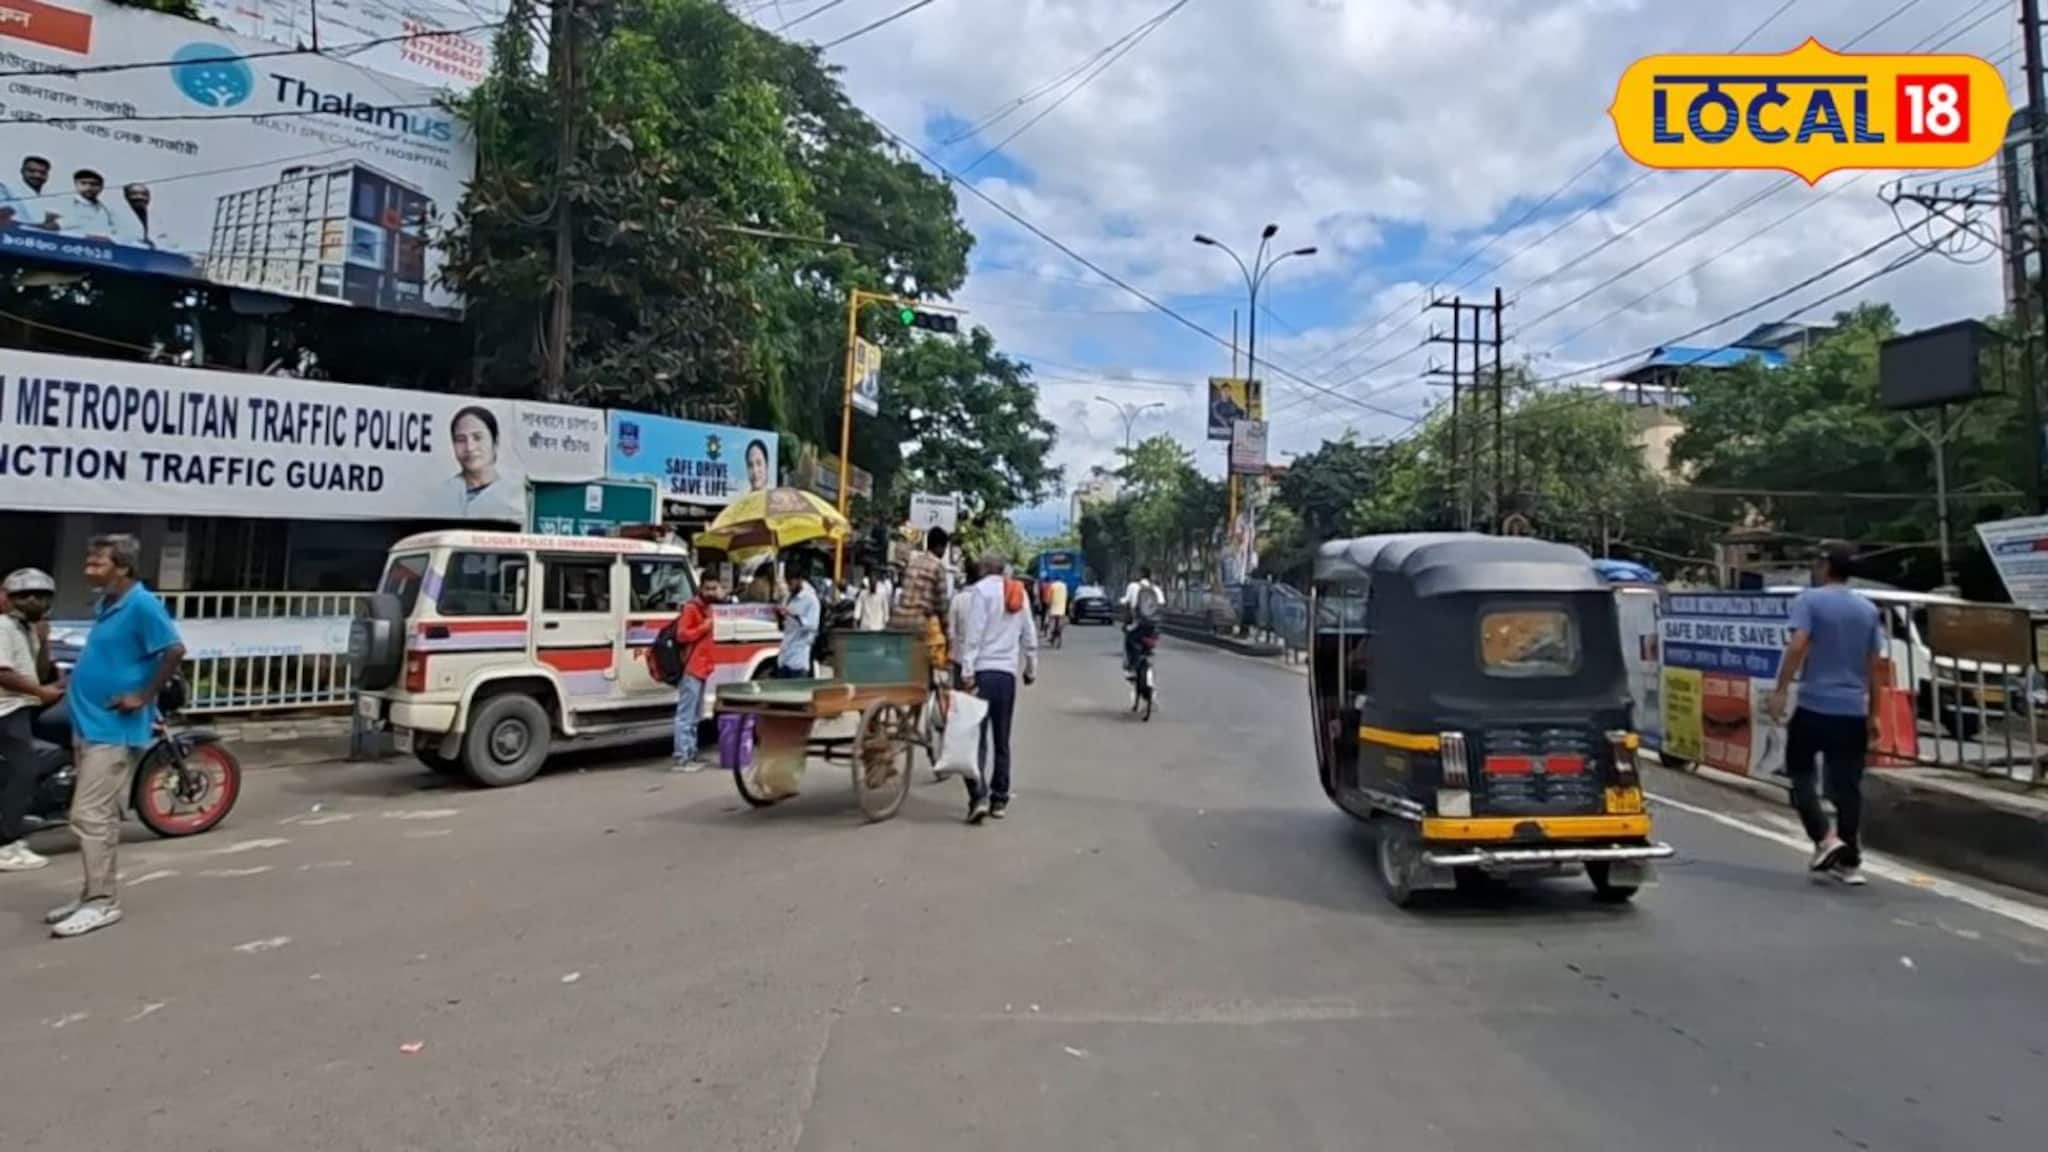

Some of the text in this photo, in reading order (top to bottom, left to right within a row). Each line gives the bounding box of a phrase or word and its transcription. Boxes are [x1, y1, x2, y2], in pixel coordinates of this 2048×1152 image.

[269, 72, 452, 142] Thalamus
[385, 147, 450, 170] HOSPITAL
[16, 376, 239, 440] METROPOLITAN
[249, 396, 349, 448] TRAFFIC
[354, 405, 433, 453] POLICE
[140, 451, 275, 488] TRAFFIC
[286, 458, 384, 492] GUARD
[665, 457, 728, 479] SAFE DRIVE
[671, 476, 728, 497] SAVE LIFE
[1665, 621, 1693, 640] SAFE
[1695, 623, 1735, 643] DRIVE
[1739, 625, 1778, 647] SAVE
